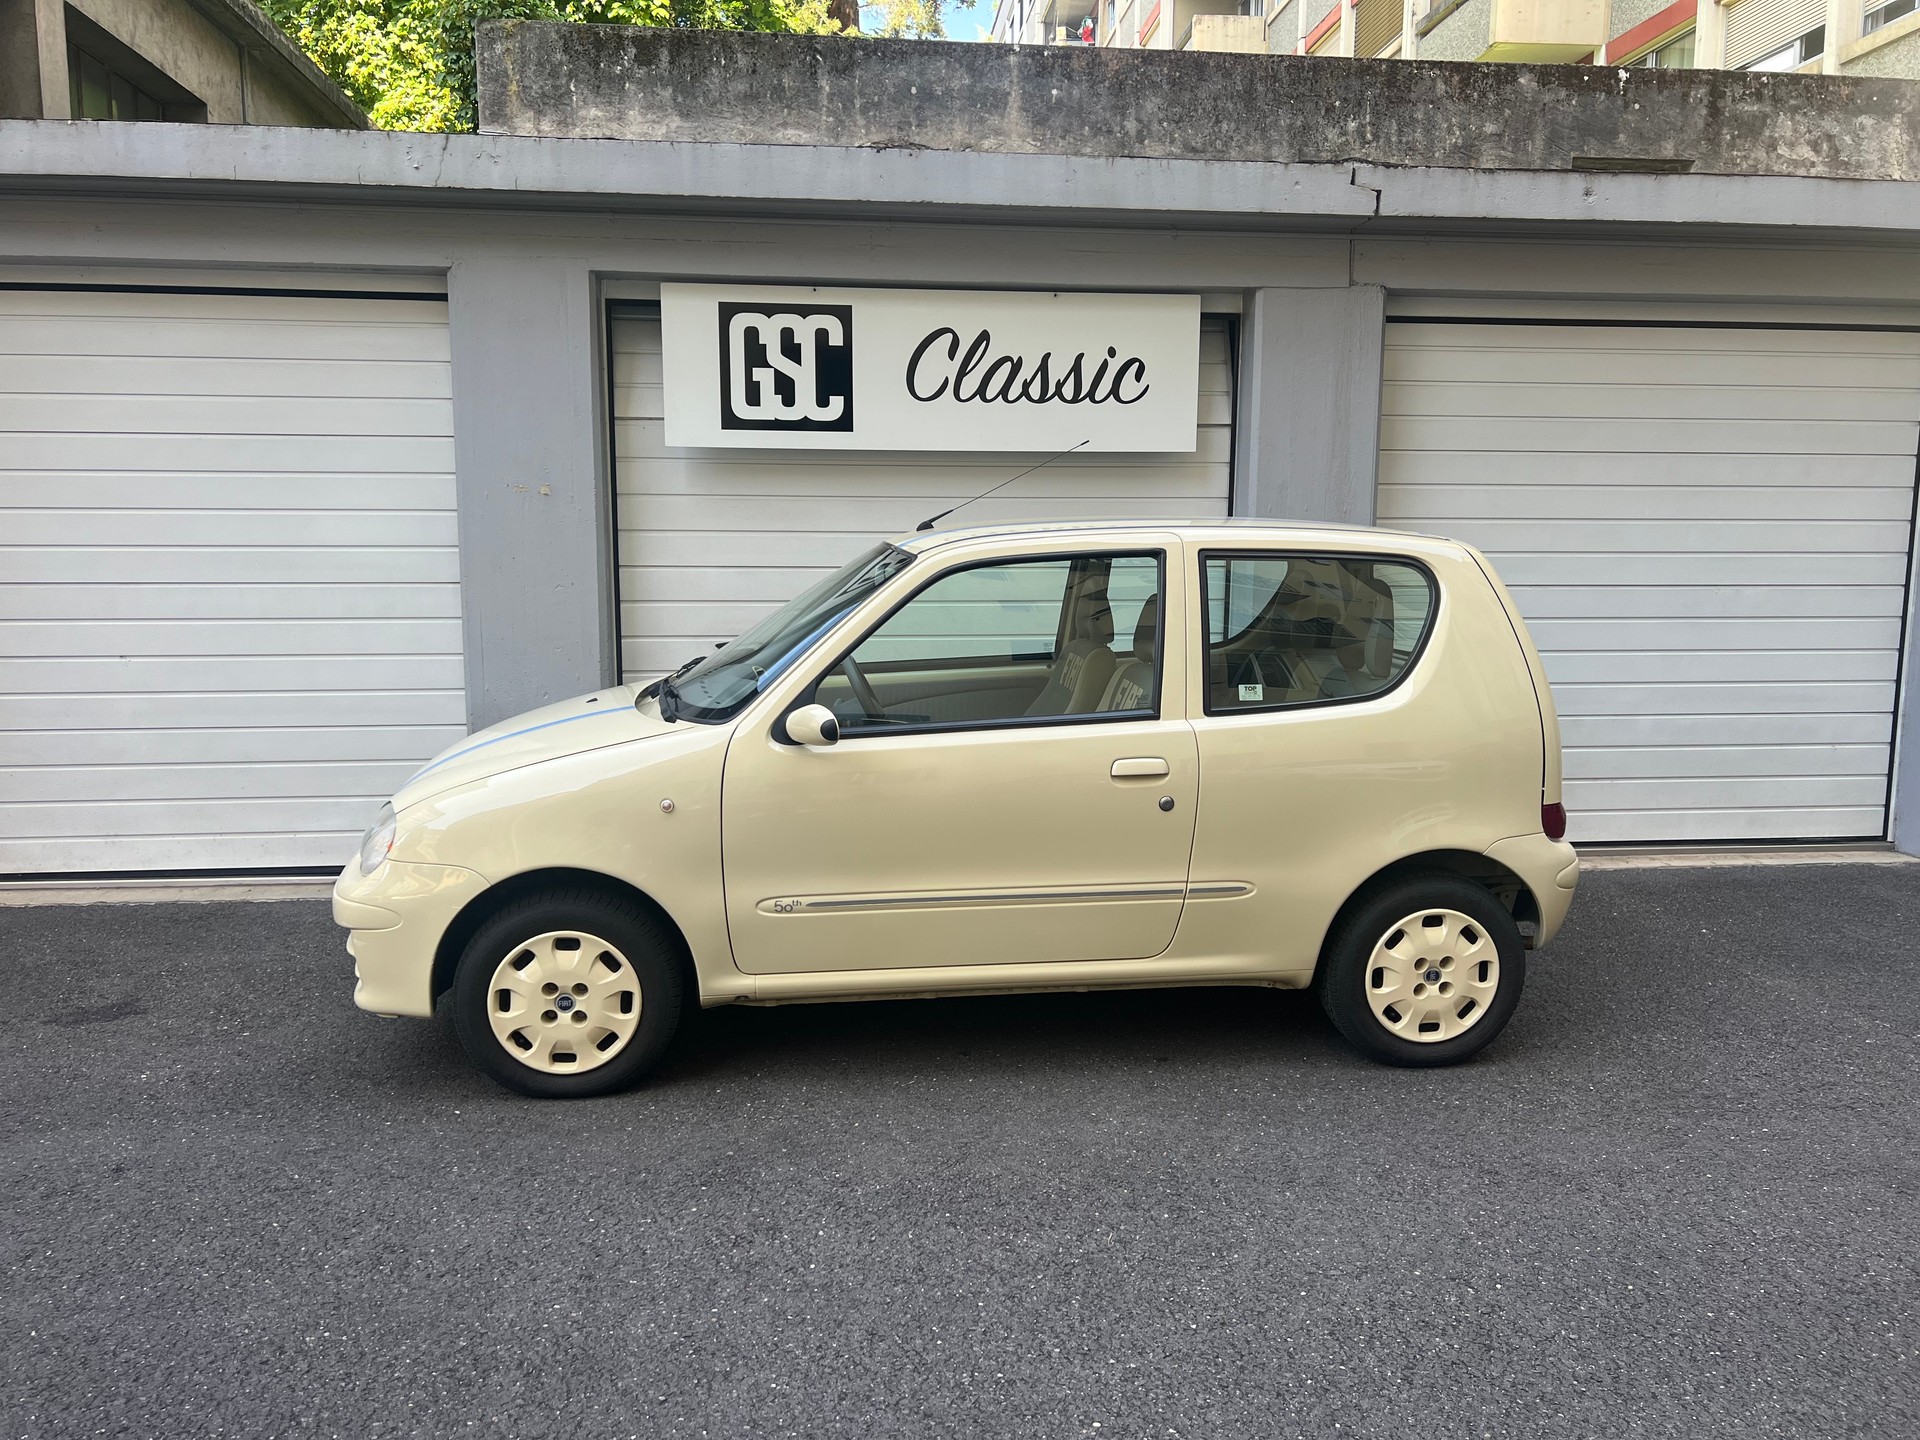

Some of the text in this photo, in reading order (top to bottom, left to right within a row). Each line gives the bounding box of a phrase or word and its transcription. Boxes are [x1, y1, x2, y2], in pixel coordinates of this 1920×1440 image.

[728, 311, 1150, 422] GSC Classic
[774, 899, 802, 913] 50th
[558, 999, 572, 1007] FIAT
